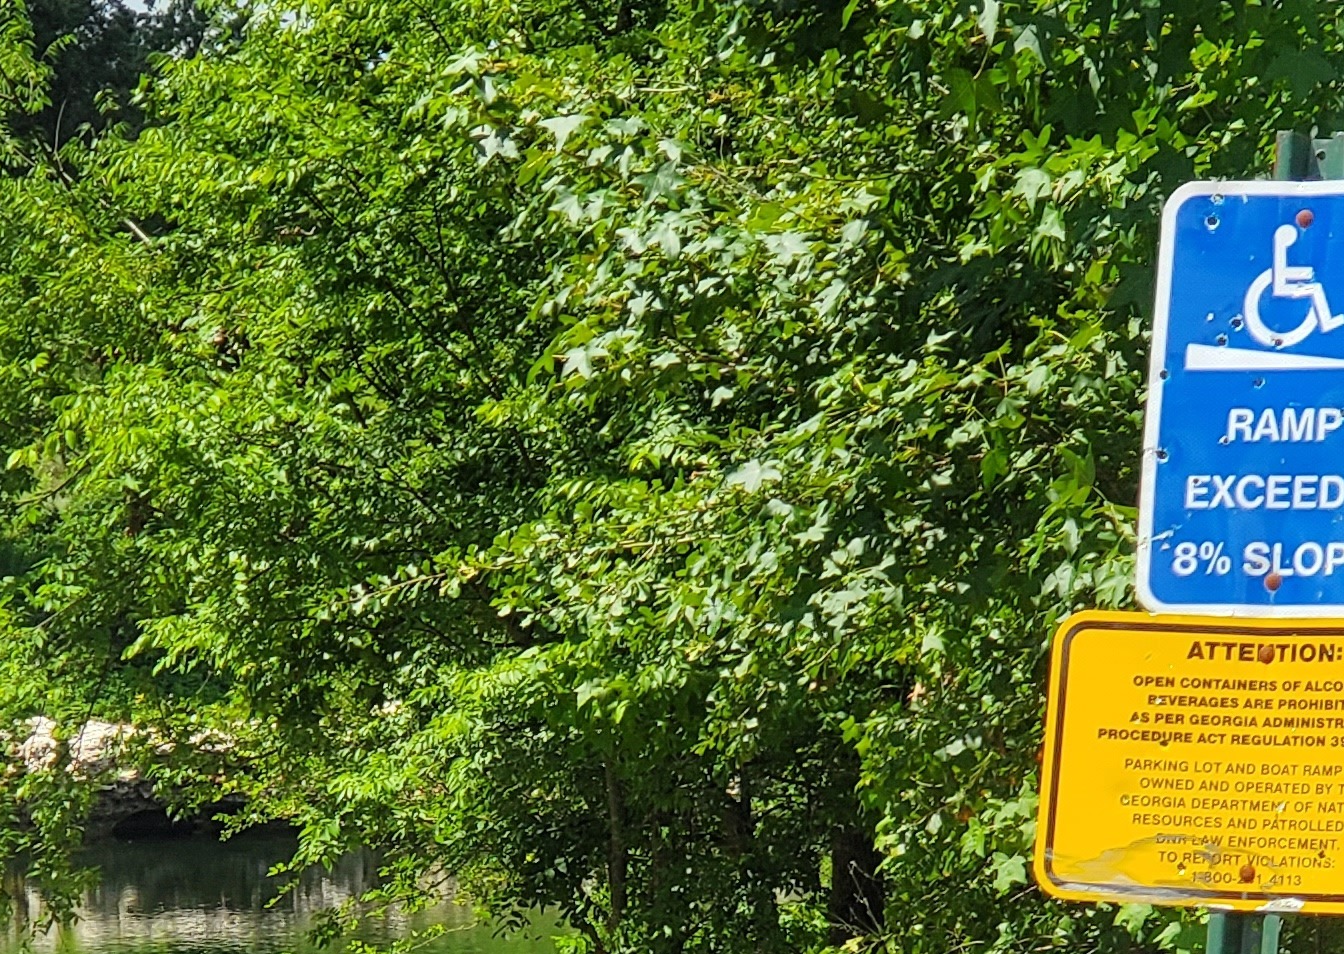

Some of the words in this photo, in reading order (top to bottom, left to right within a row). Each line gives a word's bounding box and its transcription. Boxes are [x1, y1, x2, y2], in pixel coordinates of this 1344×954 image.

[1226, 407, 1343, 442] RAMP
[1172, 541, 1231, 577] 8%
[1133, 675, 1175, 688] OPEN
[1180, 677, 1277, 691] CONTAINERS
[1282, 680, 1301, 692] OF
[1147, 694, 1239, 708] BEVERAGES
[1243, 698, 1273, 710] ARE
[1129, 711, 1150, 723] AS
[1154, 713, 1185, 725] PER
[1189, 714, 1258, 727] GEORGIA
[1097, 728, 1193, 744] PROCEDURE
[1197, 733, 1226, 745] ACT
[1230, 734, 1326, 747] REGULATION
[1125, 758, 1189, 773] PARKING
[1194, 762, 1222, 774] LOT
[1225, 763, 1256, 775] AND
[1260, 763, 1299, 776] BOAT
[1303, 765, 1343, 777] RAMP
[1139, 777, 1195, 791] OWNED
[1199, 780, 1230, 792] AND
[1234, 781, 1311, 795] OPERATED
[1315, 783, 1333, 795] BY
[1120, 794, 1186, 808] GEORGIA
[1191, 797, 1290, 812] DEPARTMENT
[1294, 801, 1313, 813] OF
[1132, 813, 1223, 828] RESOURCES
[1227, 817, 1257, 830] AND
[1262, 819, 1344, 832] PATROLLED
[1192, 835, 1224, 847] LAW
[1227, 836, 1341, 851] ENFORCEMENT.
[1158, 851, 1178, 863] TO
